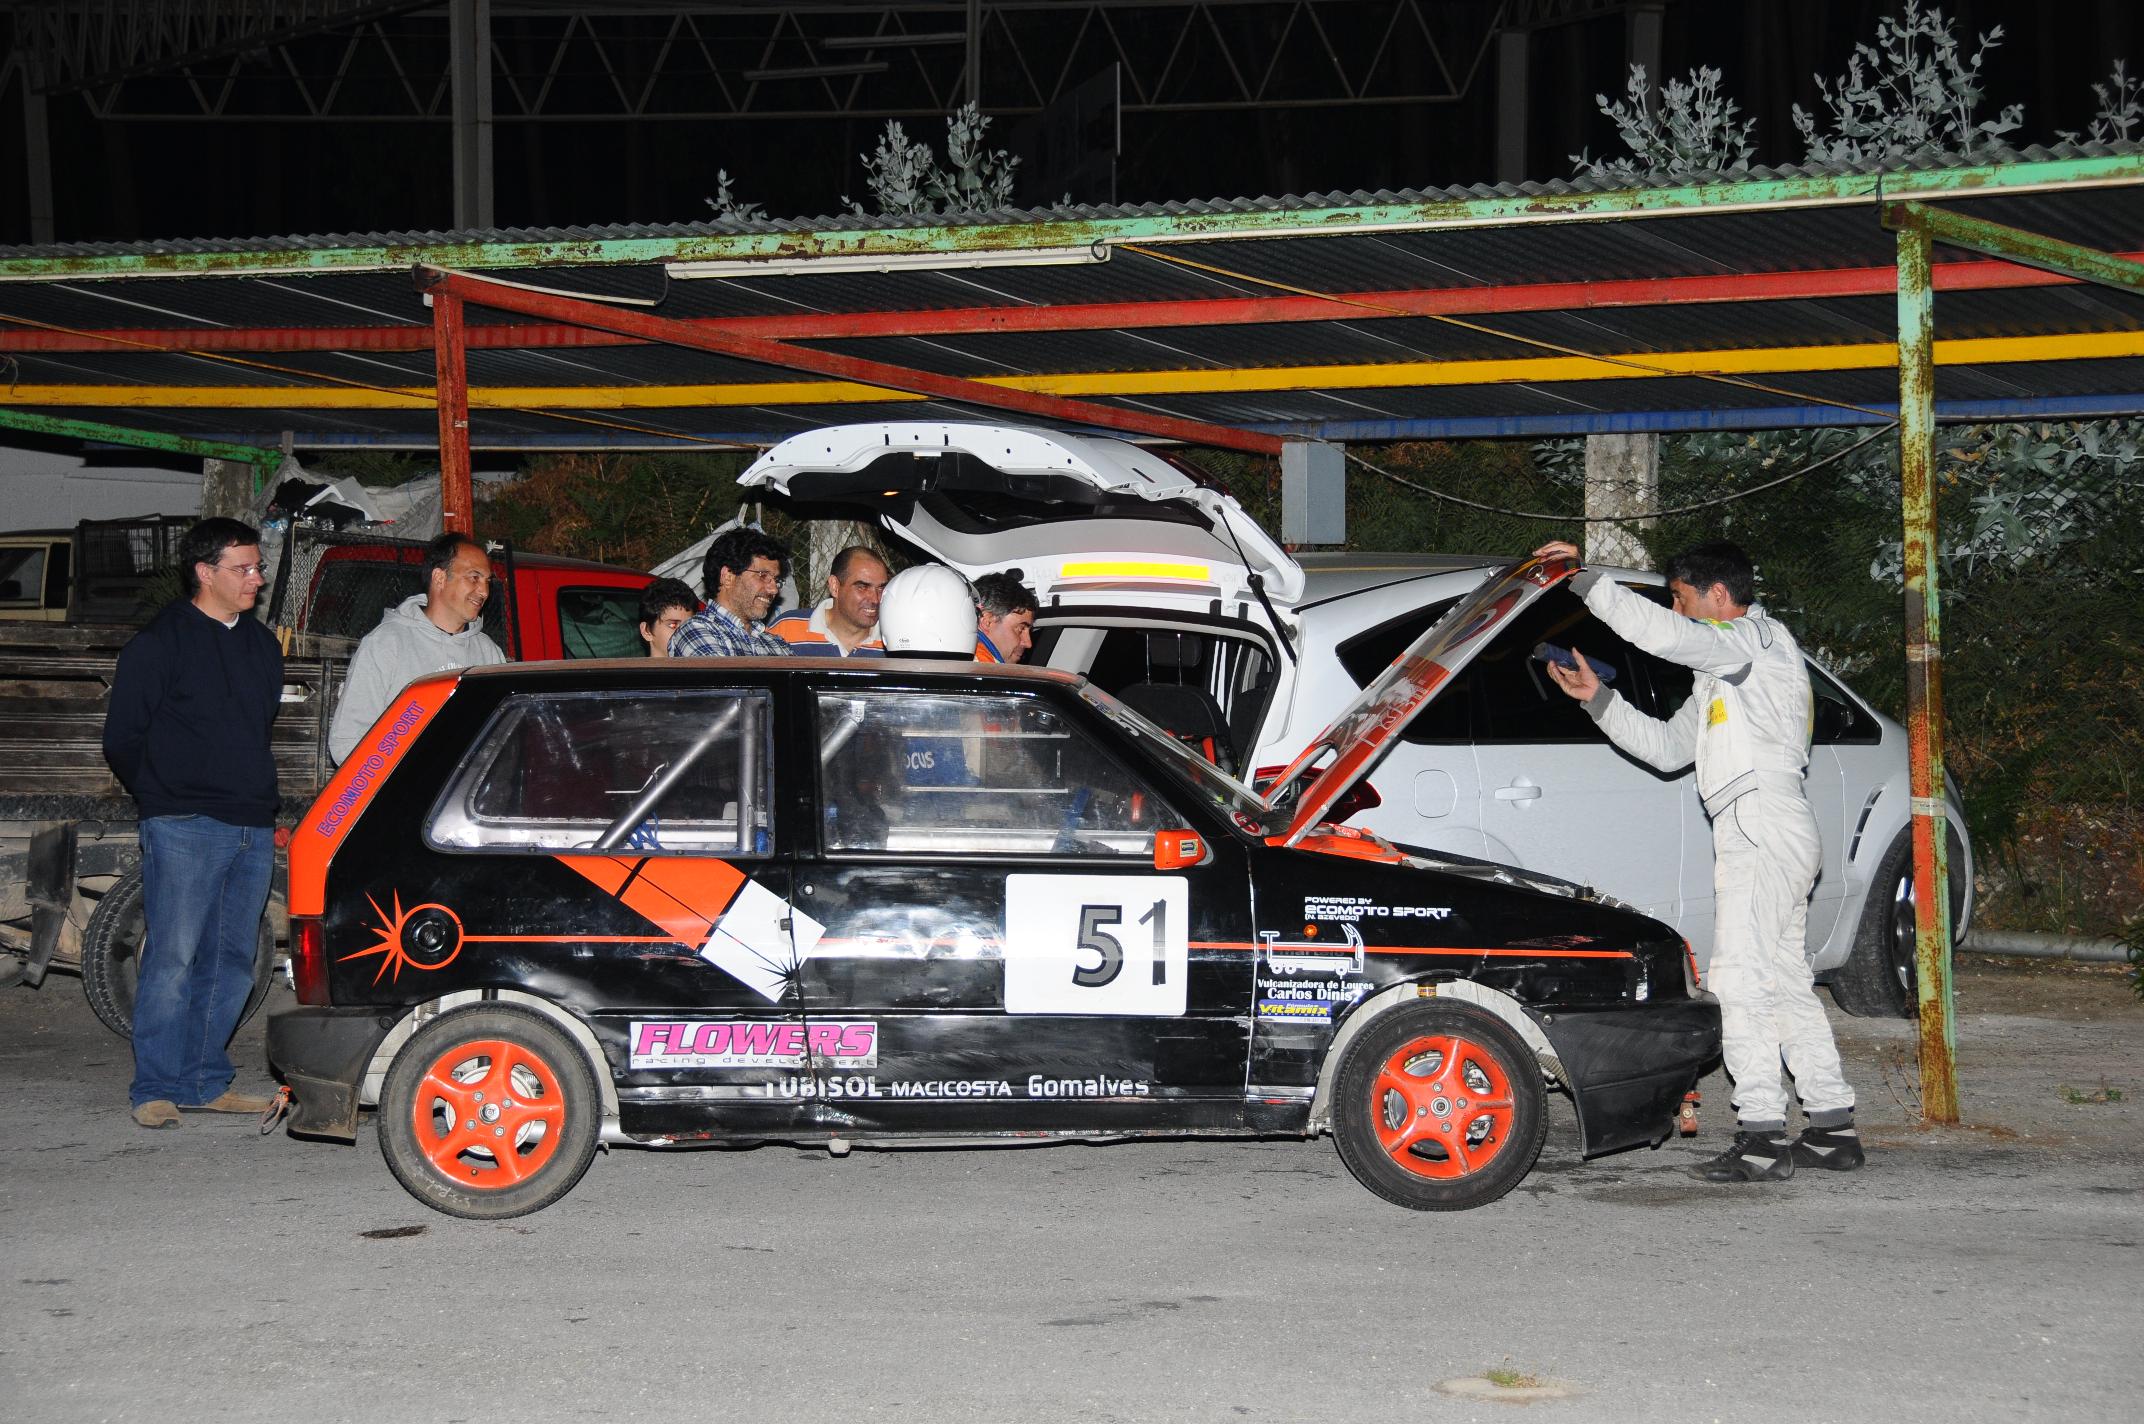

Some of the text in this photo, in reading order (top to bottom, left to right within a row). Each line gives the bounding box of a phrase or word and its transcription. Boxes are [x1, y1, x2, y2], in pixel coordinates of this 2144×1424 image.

[316, 700, 425, 838] ECOMOTO SPORT
[1304, 897, 1372, 905] POWERED BY
[1392, 907, 1451, 919] SPORT
[1072, 898, 1167, 988] 51
[1257, 979, 1374, 990] Vulcanizadora de Loures
[1267, 987, 1354, 1002] Carlos Dinis
[1259, 1003, 1329, 1015] Vitamix
[634, 1023, 875, 1057] FLOWERS
[632, 1057, 706, 1066] racing
[891, 1080, 1012, 1097] MACICOSTA
[1028, 1074, 1149, 1097] Gomalves
